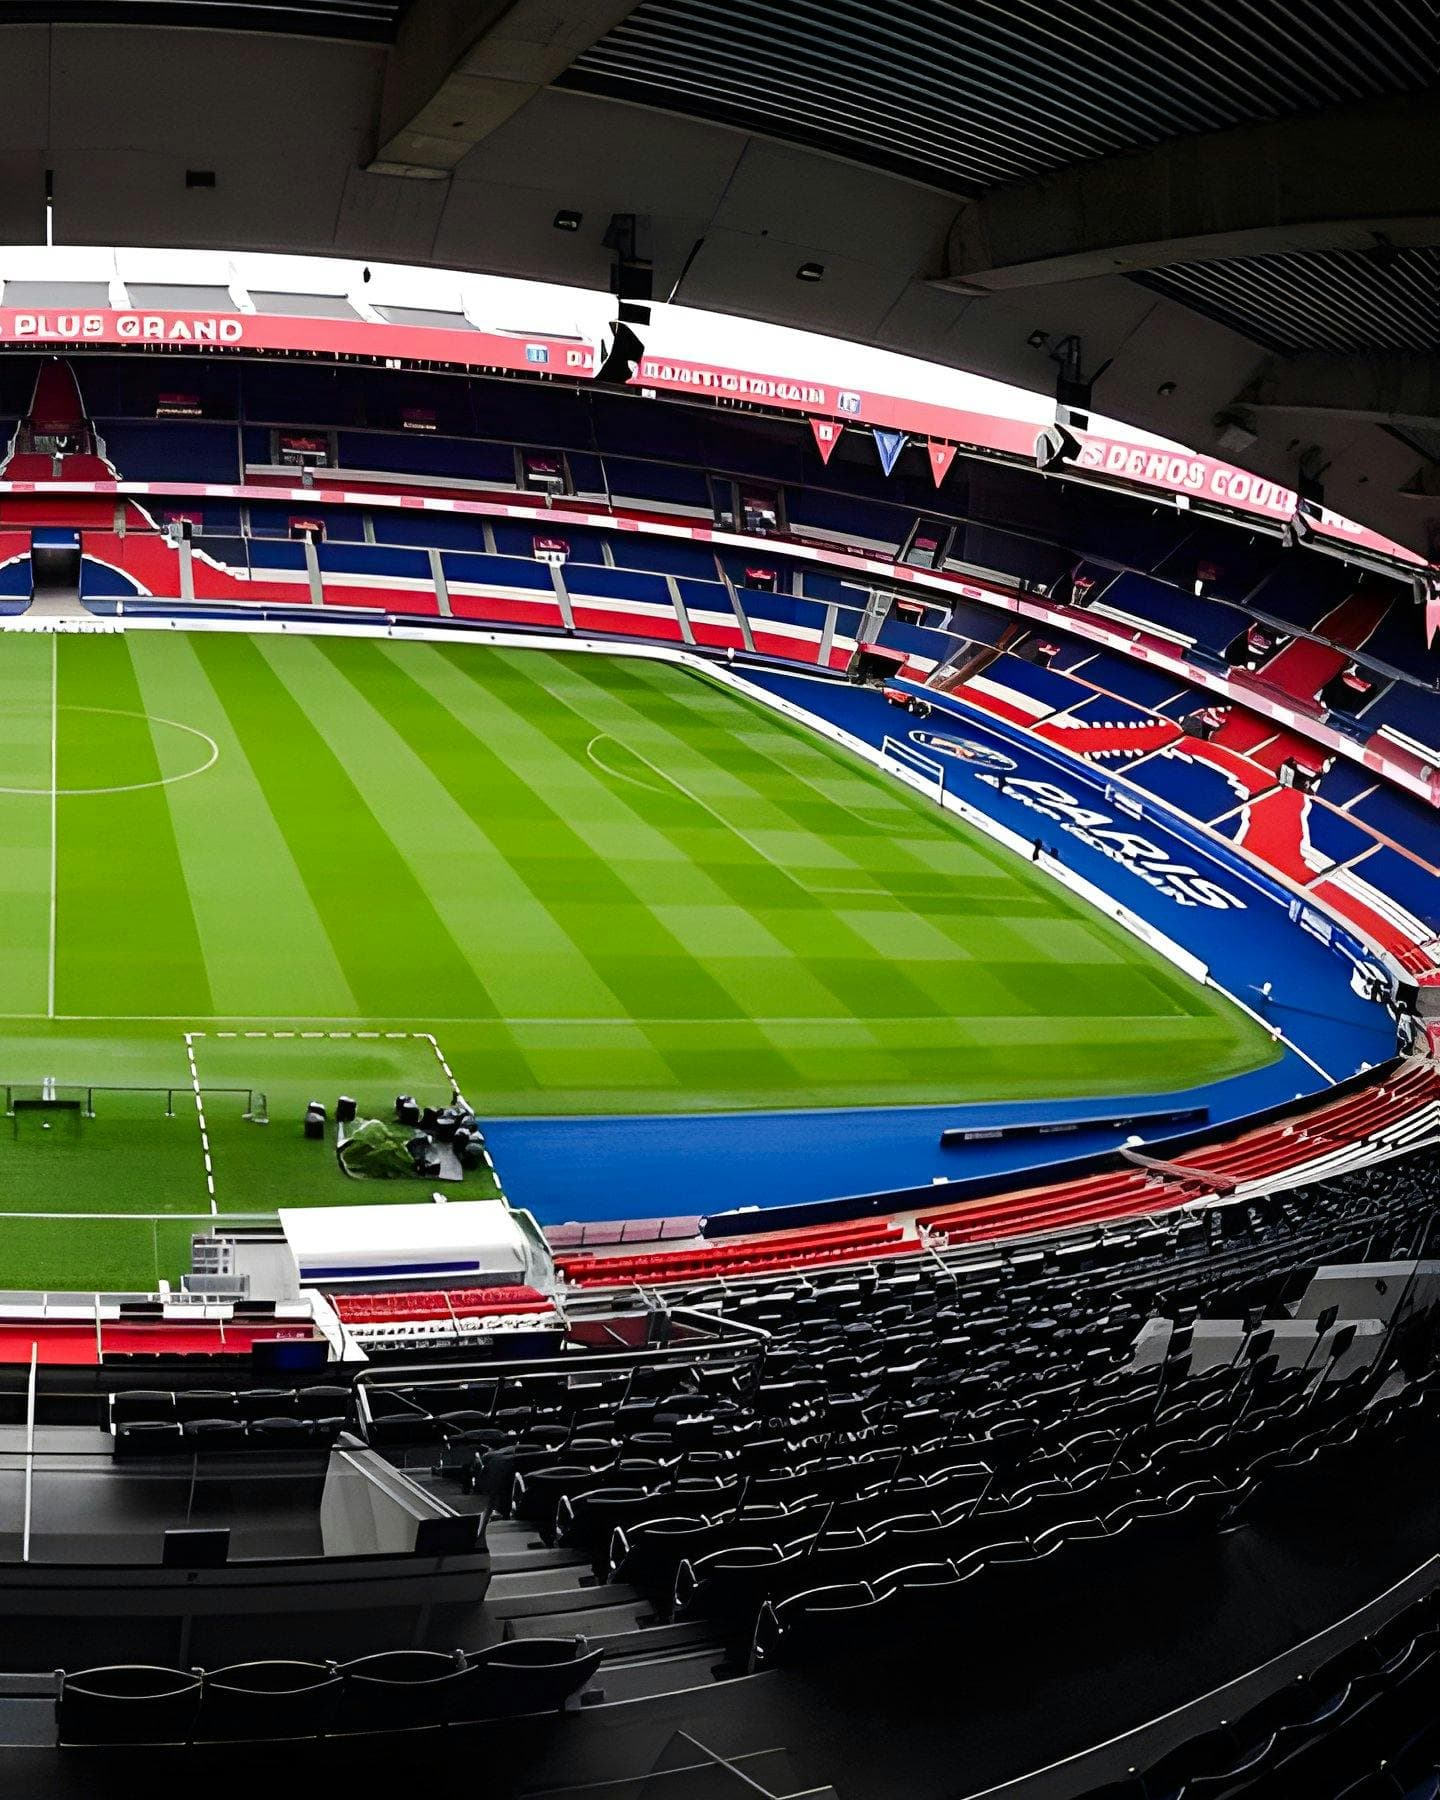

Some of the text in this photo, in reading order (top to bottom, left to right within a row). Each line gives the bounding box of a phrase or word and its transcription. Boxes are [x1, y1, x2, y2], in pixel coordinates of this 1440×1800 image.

[14, 314, 104, 339] PLUS
[116, 316, 244, 342] GRAND
[1004, 776, 1248, 910] PARIS
